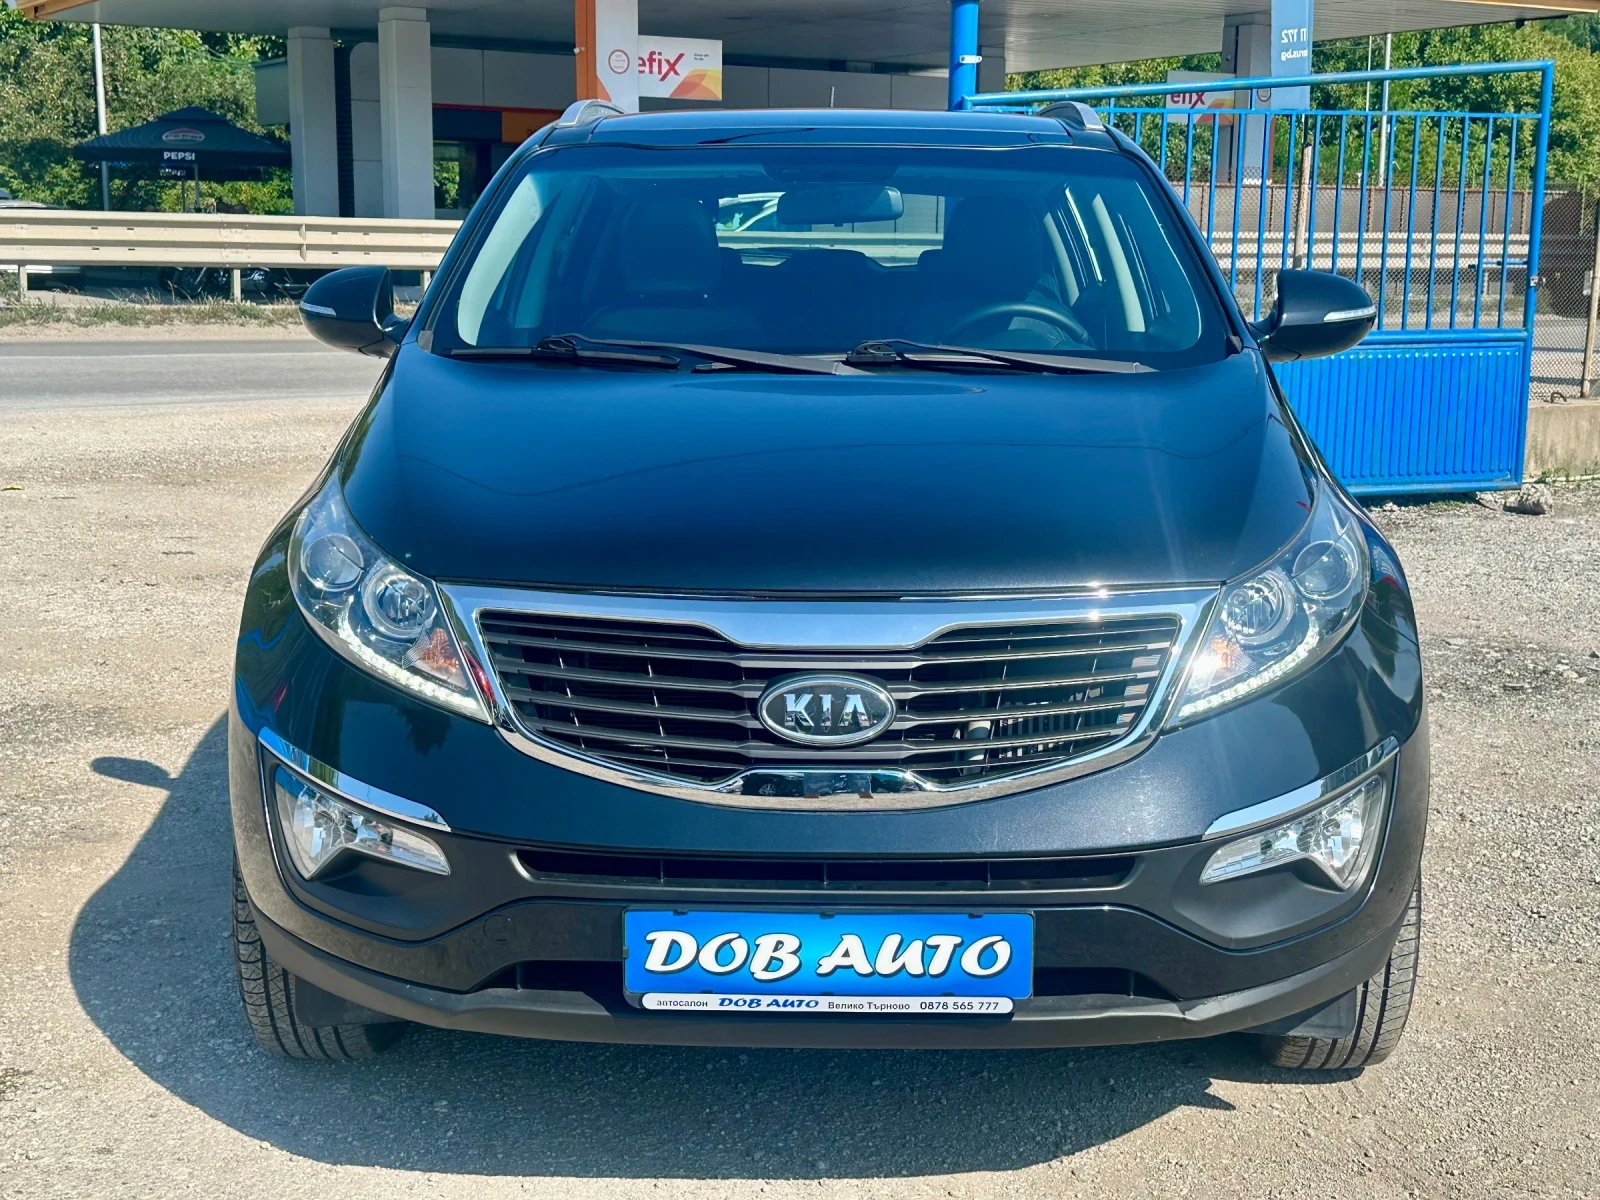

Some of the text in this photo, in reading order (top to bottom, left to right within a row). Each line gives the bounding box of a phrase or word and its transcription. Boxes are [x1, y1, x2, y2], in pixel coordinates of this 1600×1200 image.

[638, 51, 685, 82] efix
[163, 151, 196, 160] PEPSI
[783, 693, 871, 727] KIA
[644, 930, 1012, 981] DOB AUTO
[656, 997, 999, 1012] автосалон DOB AUTO Велико Търново 0878 565 777
